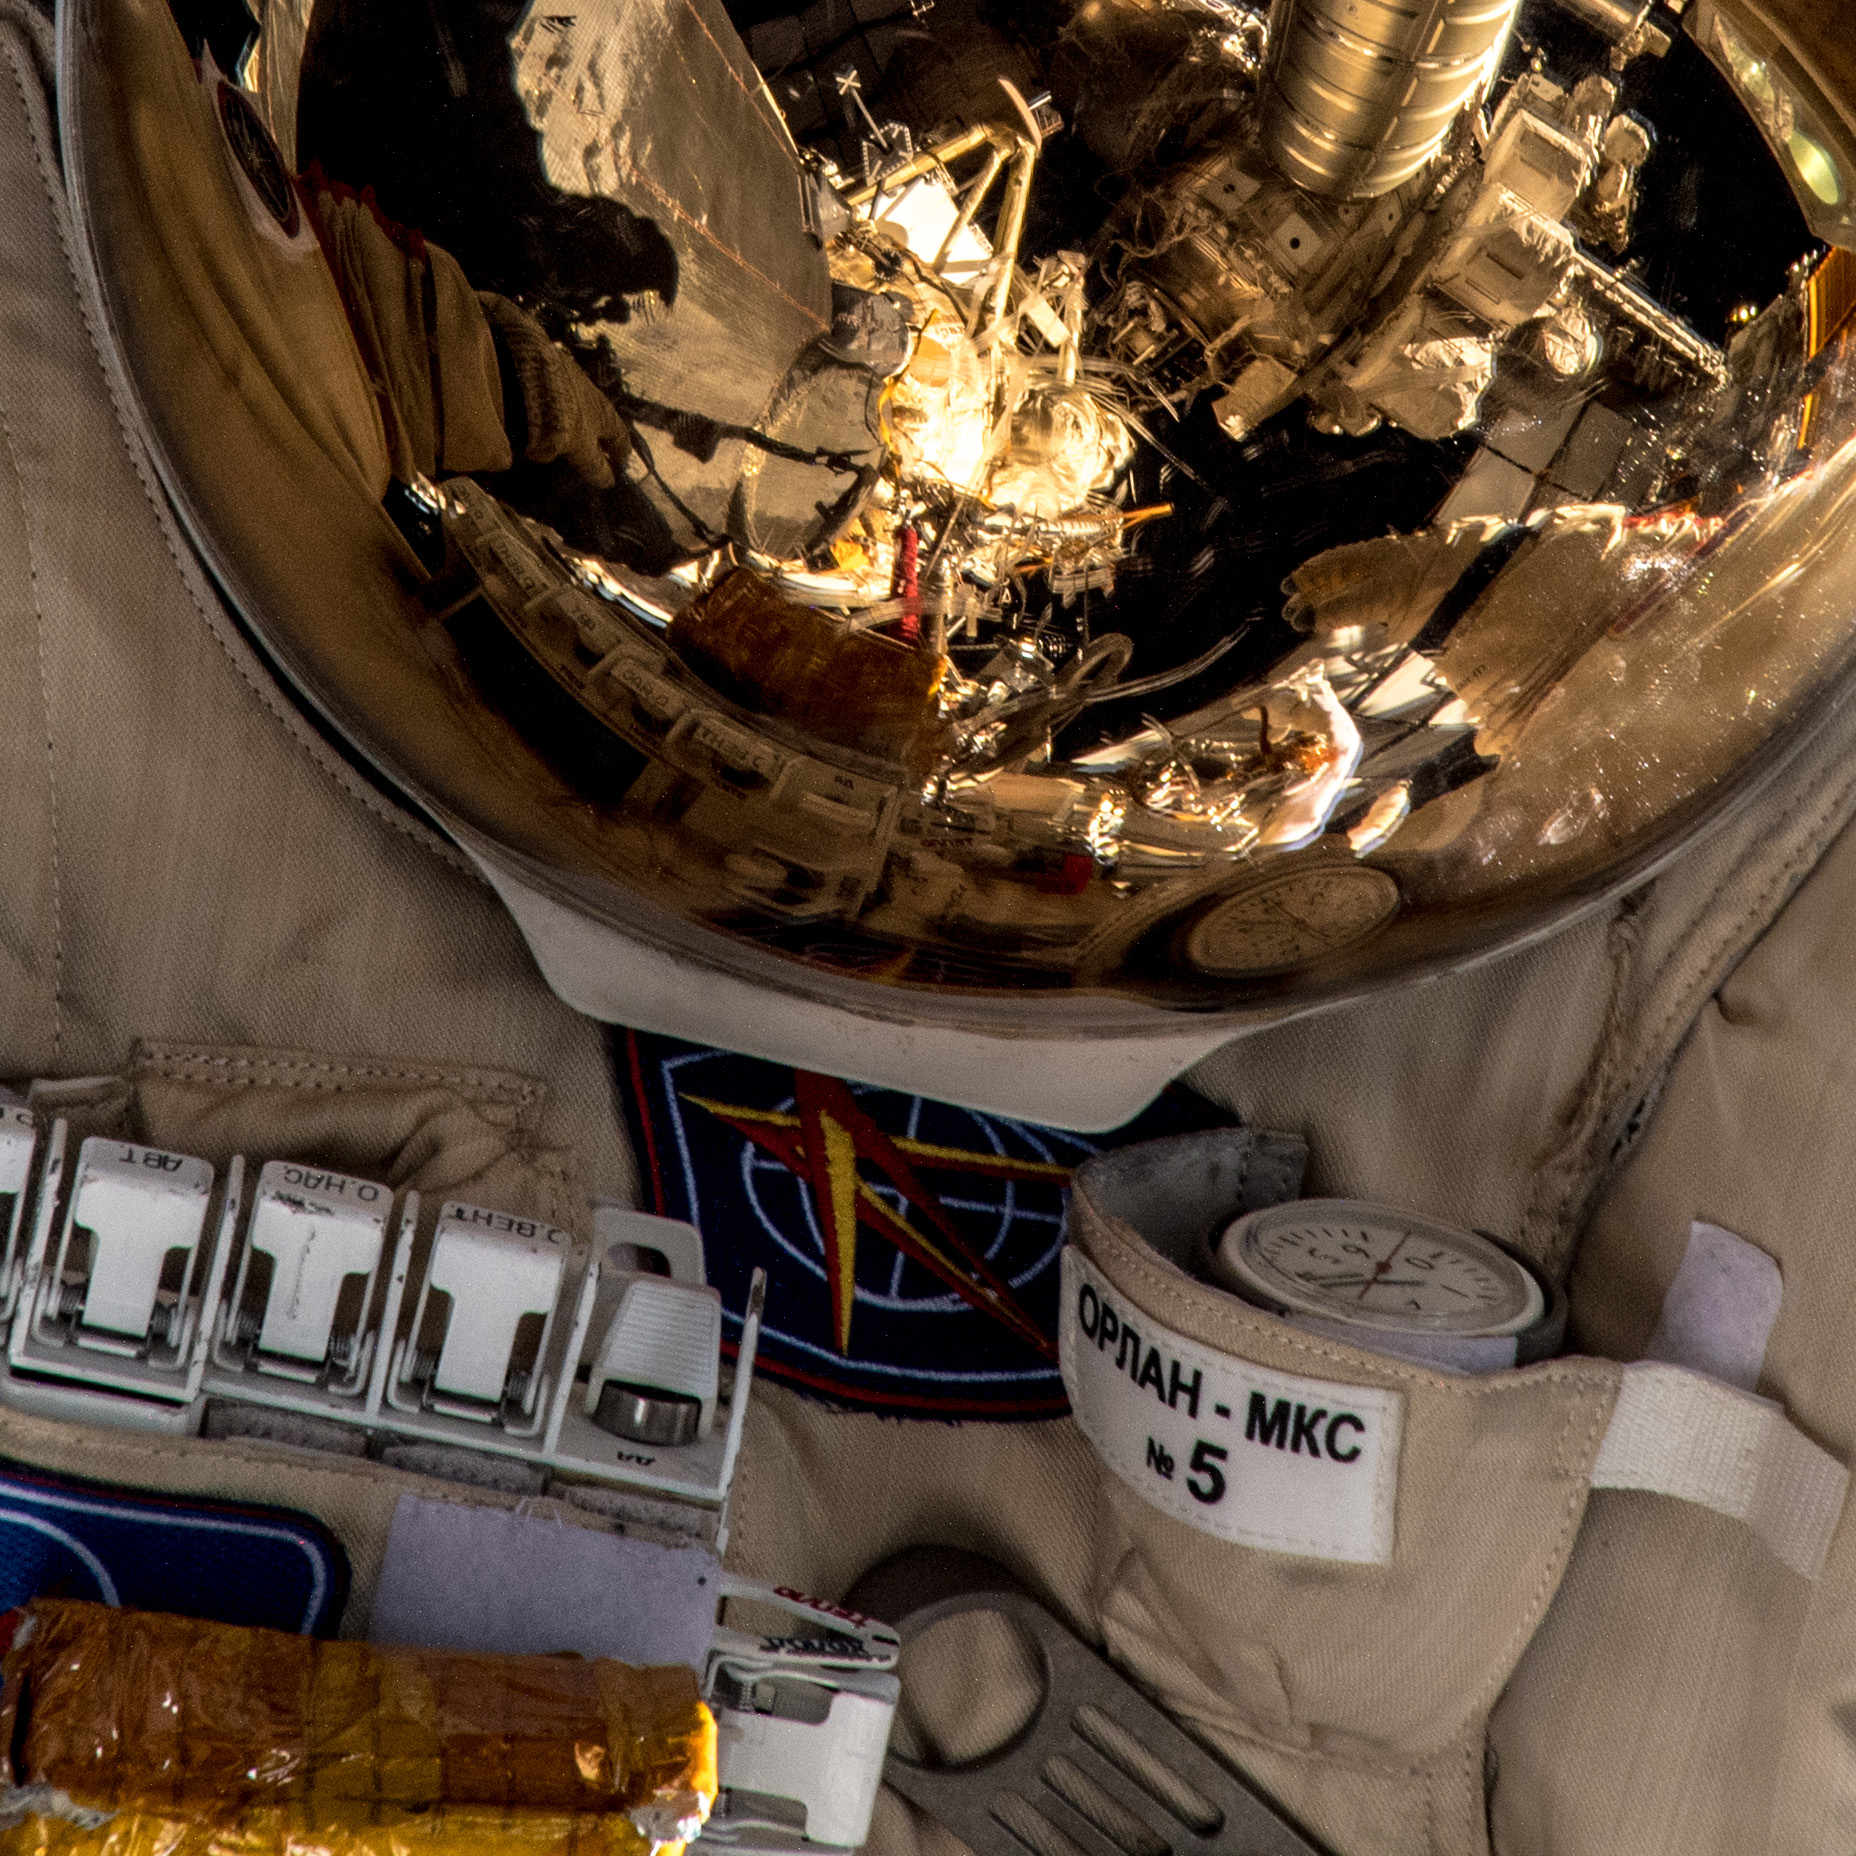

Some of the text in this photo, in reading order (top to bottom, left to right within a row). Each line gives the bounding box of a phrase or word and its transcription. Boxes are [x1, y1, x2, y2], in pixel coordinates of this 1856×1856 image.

[1078, 1282, 1202, 1419] ОРЛАН
[1244, 1391, 1366, 1463] МКС
[1186, 1439, 1228, 1505] 5
